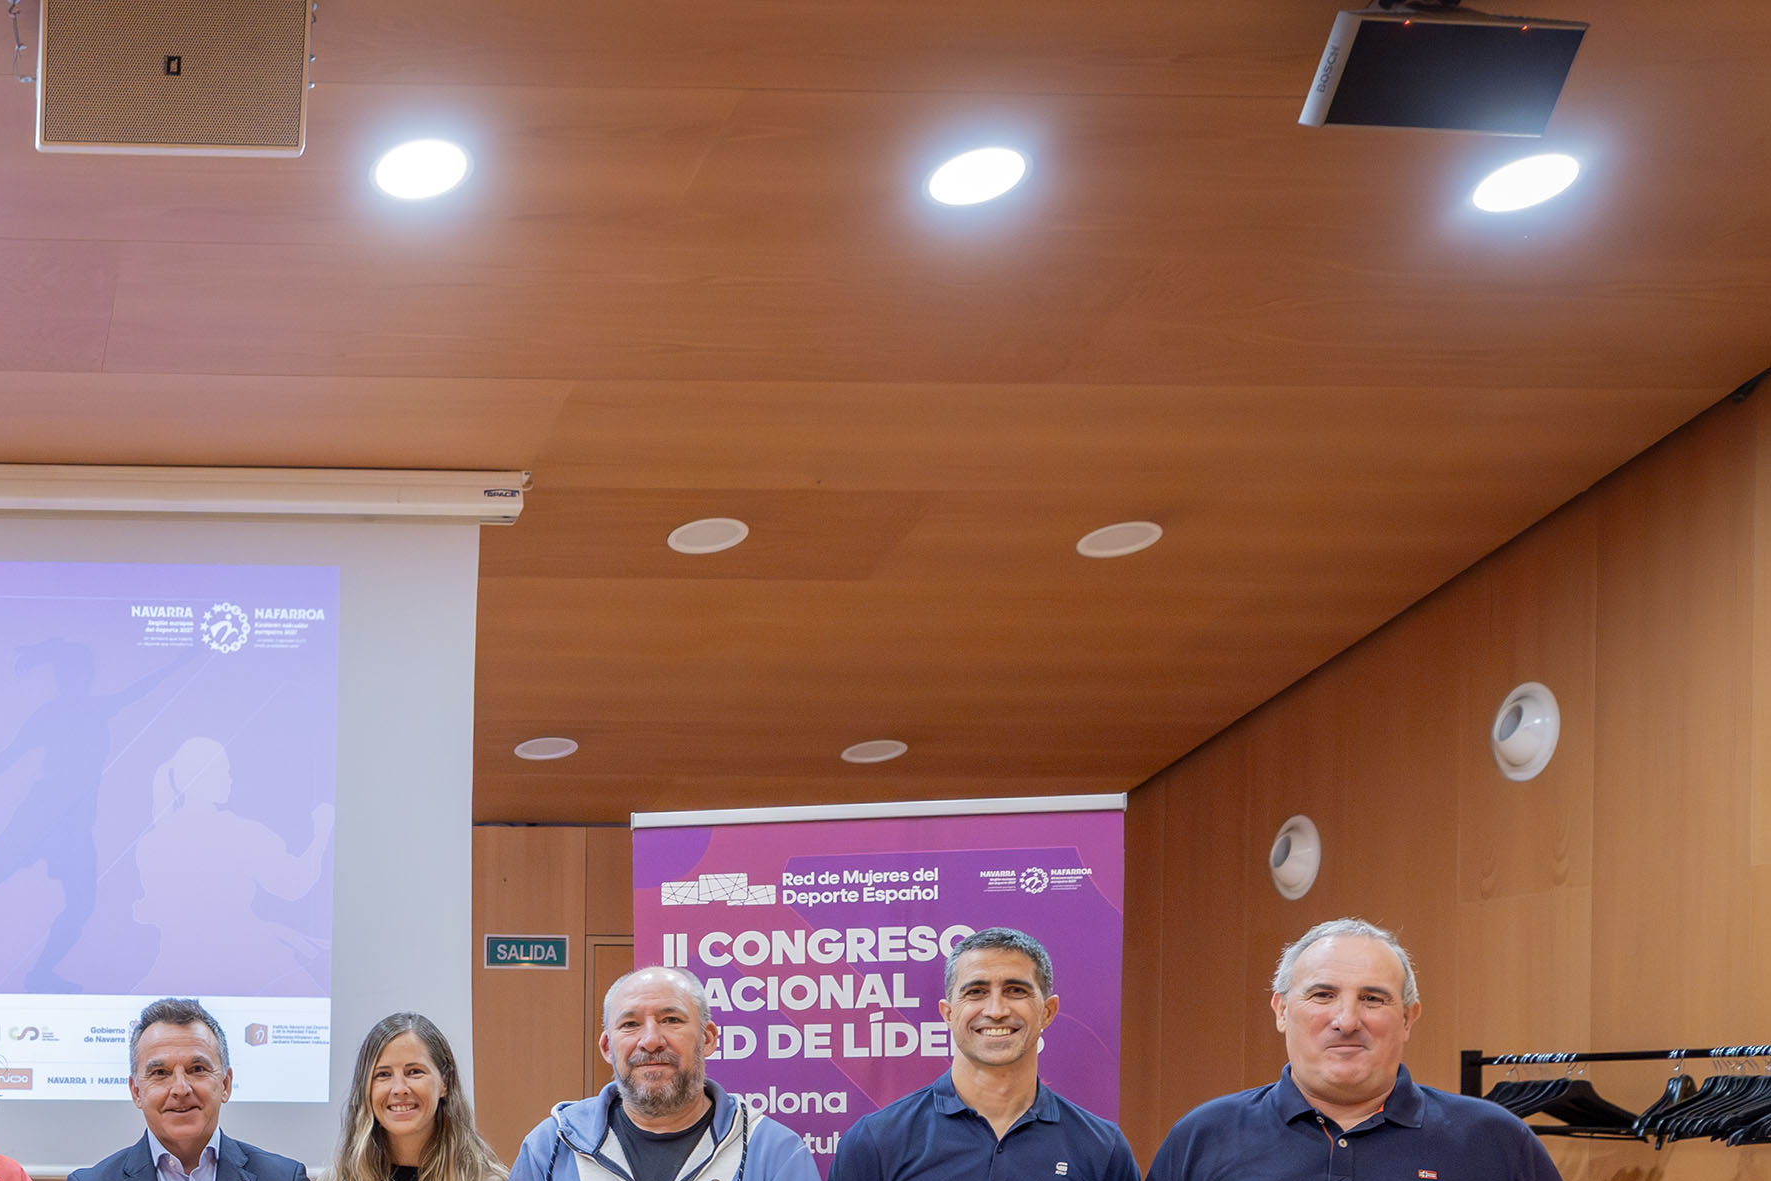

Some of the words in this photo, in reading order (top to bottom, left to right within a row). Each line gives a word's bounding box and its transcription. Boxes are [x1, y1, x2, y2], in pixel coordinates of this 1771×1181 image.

[1316, 45, 1340, 92] BOSCH
[132, 606, 193, 617] NAVARRA
[255, 609, 324, 619] NAFARROA
[783, 872, 814, 885] Red
[818, 872, 839, 884] de
[844, 870, 909, 886] Mujeres
[913, 868, 938, 881] del
[783, 887, 859, 907] Deporte
[863, 885, 938, 904] Español
[496, 944, 557, 961] SALIDA
[662, 934, 687, 967] II
[702, 973, 919, 1012] ACIONAL
[90, 1026, 125, 1035] Gobierno
[768, 1024, 832, 1058] DE
